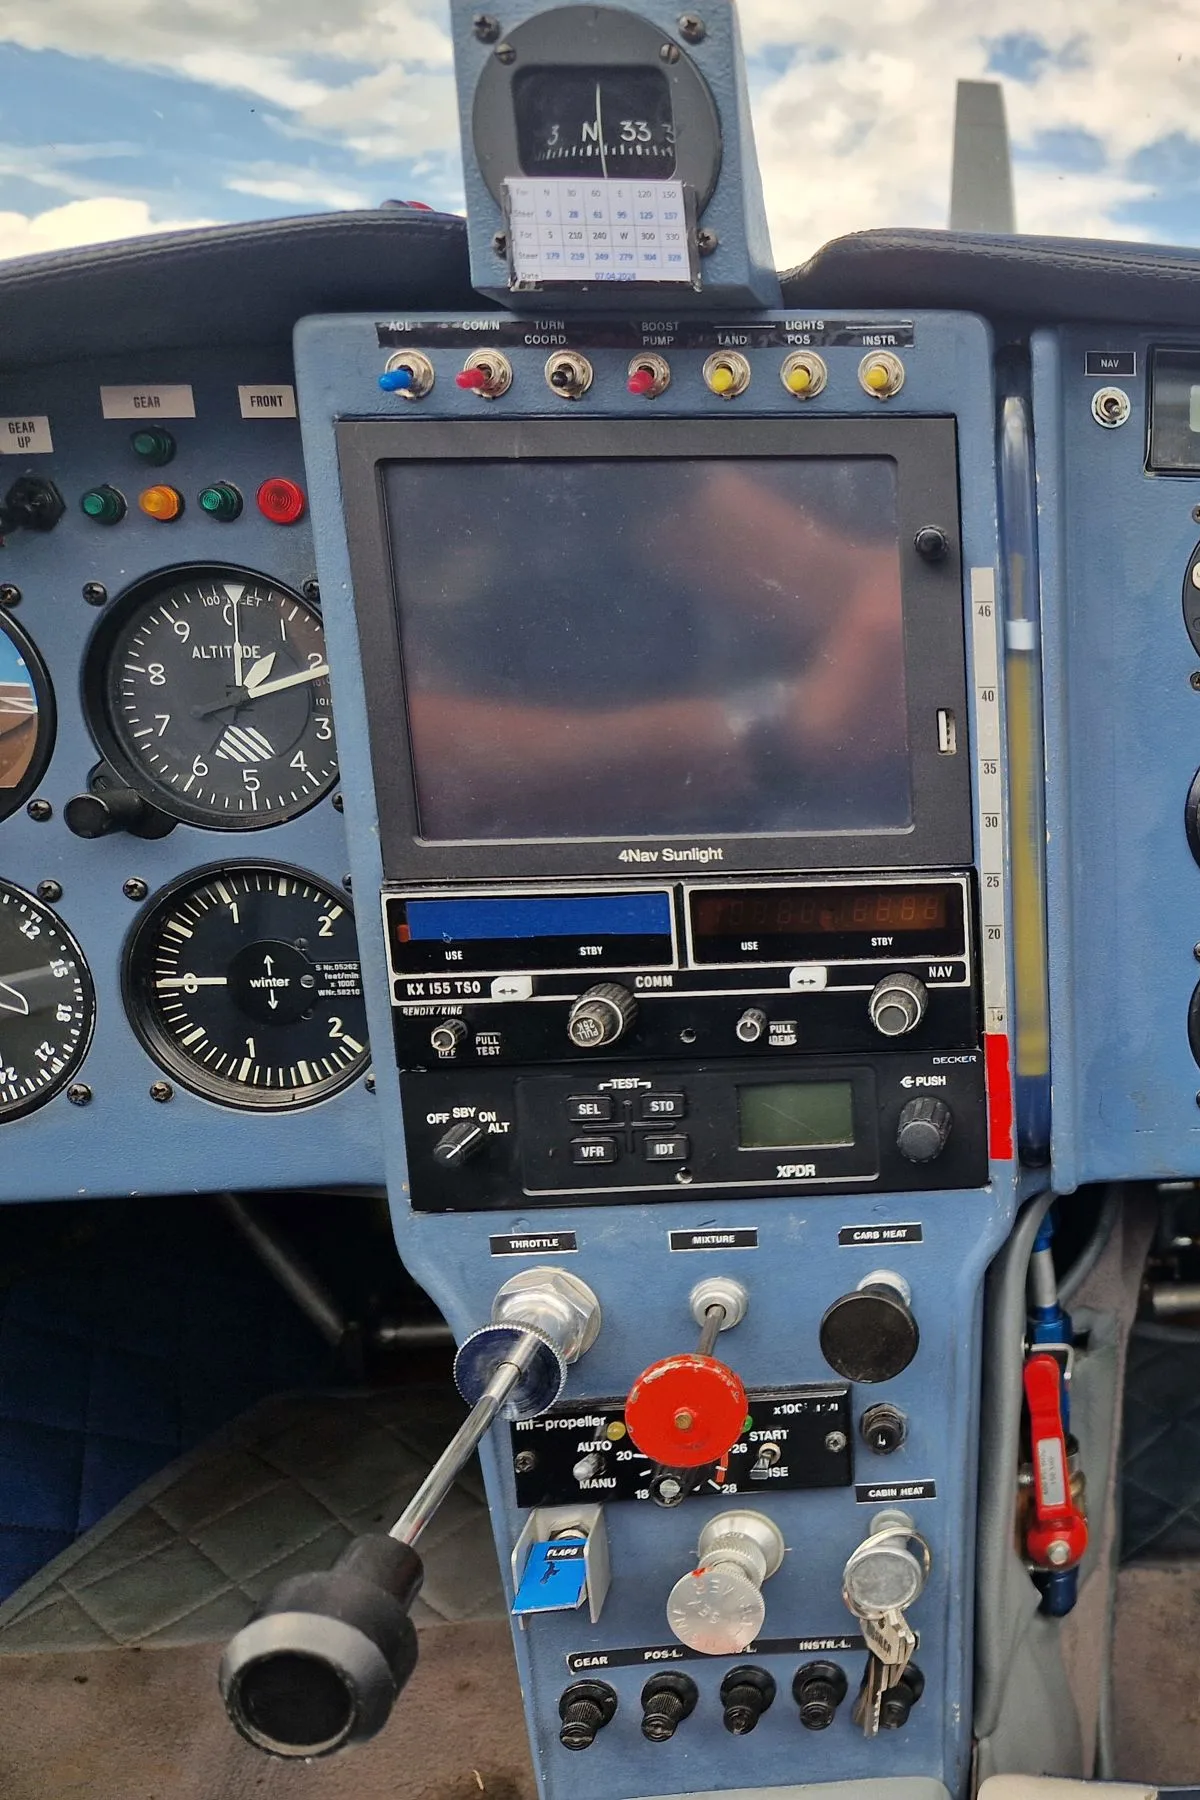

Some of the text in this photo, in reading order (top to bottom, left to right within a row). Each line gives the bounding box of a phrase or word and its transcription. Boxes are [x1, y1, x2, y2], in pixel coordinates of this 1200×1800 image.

[582, 120, 652, 142] N 33
[592, 232, 607, 240] 240
[665, 233, 680, 241] 330
[388, 321, 411, 332] ACL
[535, 321, 565, 330] TURN
[641, 322, 679, 332] BOOST
[785, 320, 825, 331] LIGHTS
[524, 335, 569, 345] COORD.
[643, 335, 674, 345] PUMP
[718, 335, 748, 345] LAND
[787, 334, 811, 345] POS
[862, 335, 898, 346] INSTR.
[1101, 358, 1119, 368] NAV
[133, 396, 161, 409] GEAR
[250, 395, 284, 408] FRONT
[8, 421, 36, 434] GEAR
[17, 437, 32, 449] UP
[191, 645, 262, 659] ALTITDE
[981, 691, 995, 702] 40
[983, 763, 997, 774] 35
[985, 817, 999, 828] 30
[618, 847, 723, 863] 4Nav Sunlight
[986, 876, 1000, 888] 25
[19, 919, 41, 940] 12
[987, 928, 1001, 940] 20
[741, 941, 758, 951] USE
[871, 937, 894, 947] STBY
[445, 950, 463, 960] USE
[579, 946, 603, 956] STBY
[49, 958, 69, 979] 15
[928, 966, 953, 978] NAV
[249, 976, 291, 989] winter
[635, 975, 673, 988] COMM
[406, 980, 481, 995] KX 155 TSO
[55, 1003, 73, 1023] 18
[403, 1007, 463, 1016] BENDIX/KING
[770, 1025, 794, 1034] PULL
[476, 1035, 499, 1045] PULL
[34, 1041, 56, 1062] 21
[476, 1046, 500, 1056] TEST
[932, 1055, 977, 1065] BECKER
[610, 1078, 640, 1089] TEST
[915, 1075, 947, 1087] PUSH
[452, 1107, 476, 1118] SBY
[578, 1103, 601, 1115] SEL
[426, 1112, 450, 1124] OFF
[478, 1111, 497, 1122] ON
[487, 1122, 511, 1133] ALT
[581, 1146, 605, 1158] VFR
[655, 1143, 675, 1155] IDT
[776, 1165, 816, 1178] XPDR
[692, 1234, 736, 1245] MIXTURE
[853, 1229, 907, 1241] CARB HEAT
[509, 1237, 560, 1248] THROTTLE
[516, 1416, 607, 1431] mt-propeller
[749, 1429, 787, 1442] START
[577, 1440, 613, 1452] AUTO
[731, 1443, 748, 1454] 26
[616, 1450, 633, 1461] 20
[579, 1477, 616, 1490] MANU
[721, 1483, 737, 1494] 28
[635, 1489, 650, 1500] 18
[868, 1487, 924, 1497] CABIN HEAT
[546, 1548, 579, 1557] FLAPS
[644, 1650, 683, 1660] POS-L.
[573, 1656, 608, 1668] GEAR
